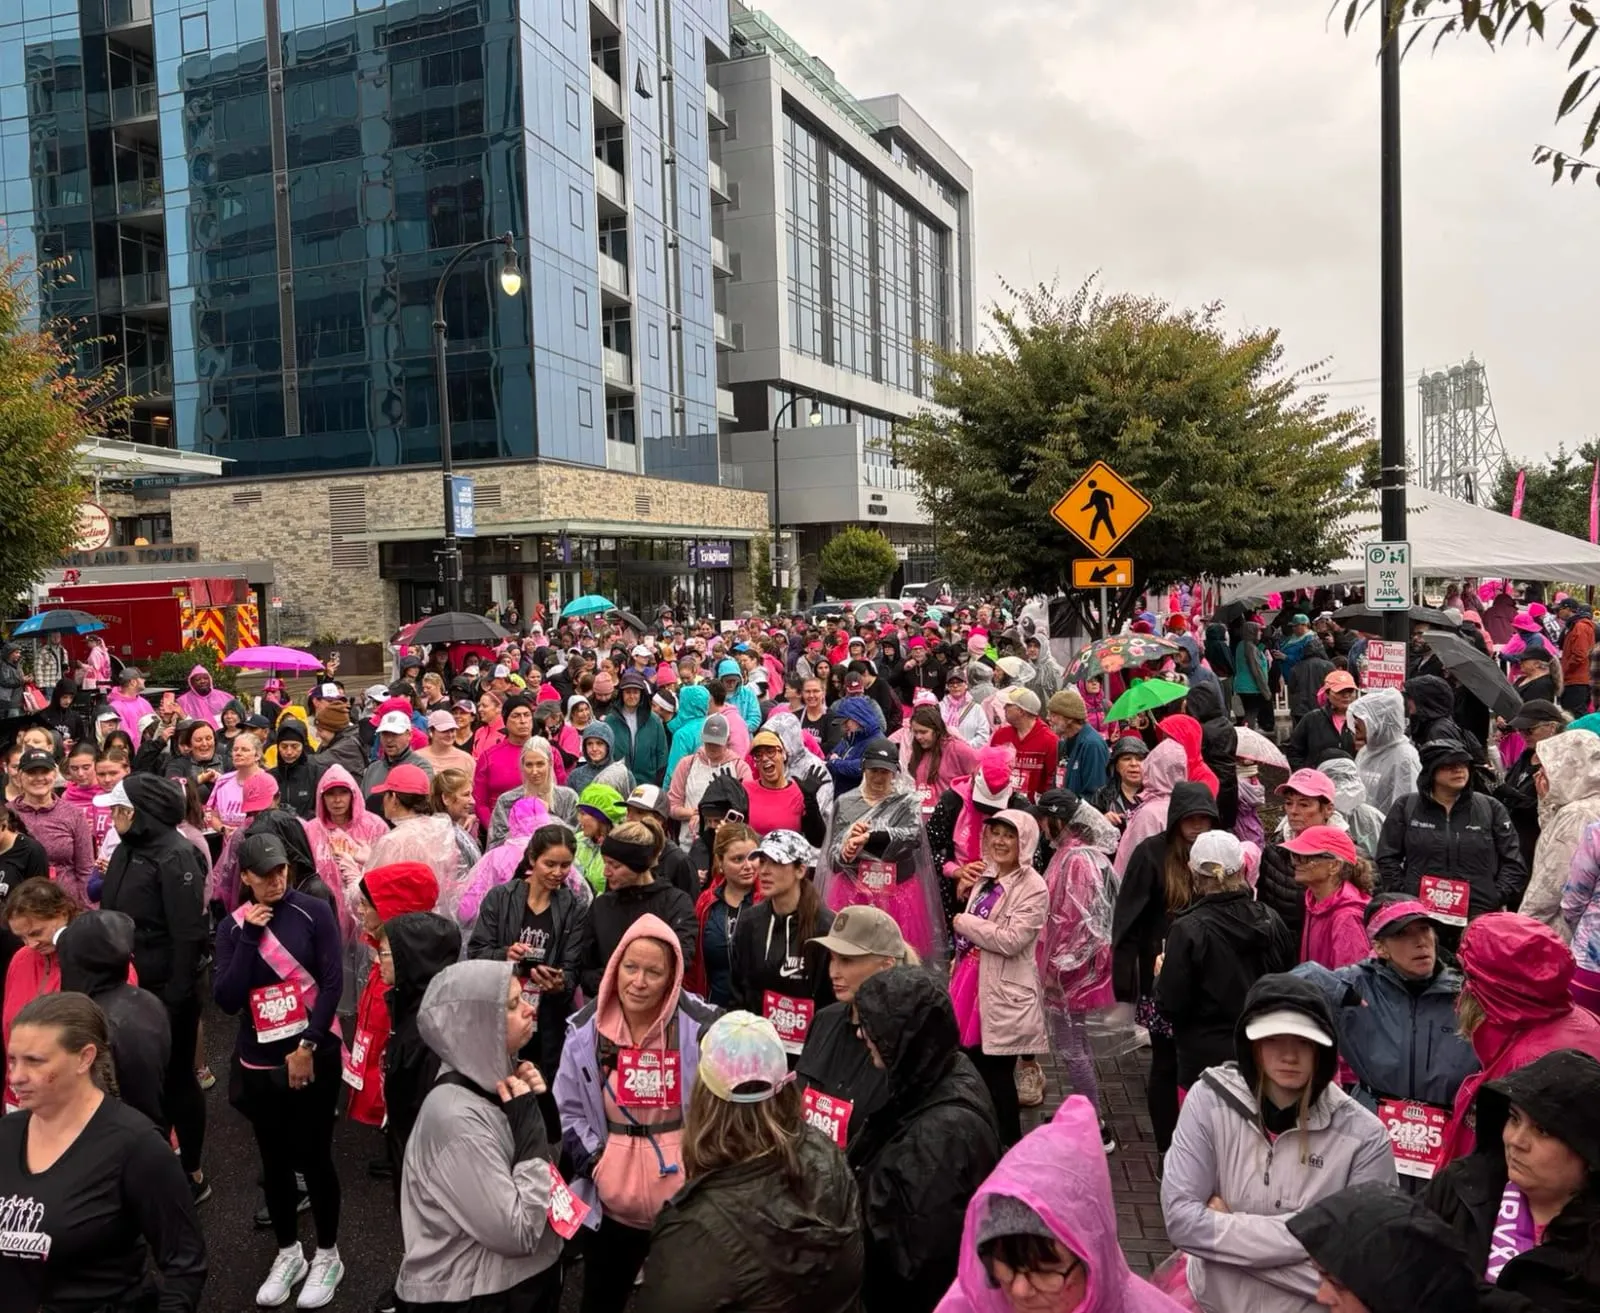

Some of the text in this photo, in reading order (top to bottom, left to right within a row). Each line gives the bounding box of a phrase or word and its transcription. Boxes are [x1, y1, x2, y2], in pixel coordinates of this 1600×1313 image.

[136, 547, 196, 563] TOWER
[1380, 570, 1397, 579] PAY
[1383, 579, 1394, 588] TO
[1376, 588, 1400, 597] PARK
[1369, 643, 1383, 659] NO
[1383, 664, 1403, 672] BLOCK
